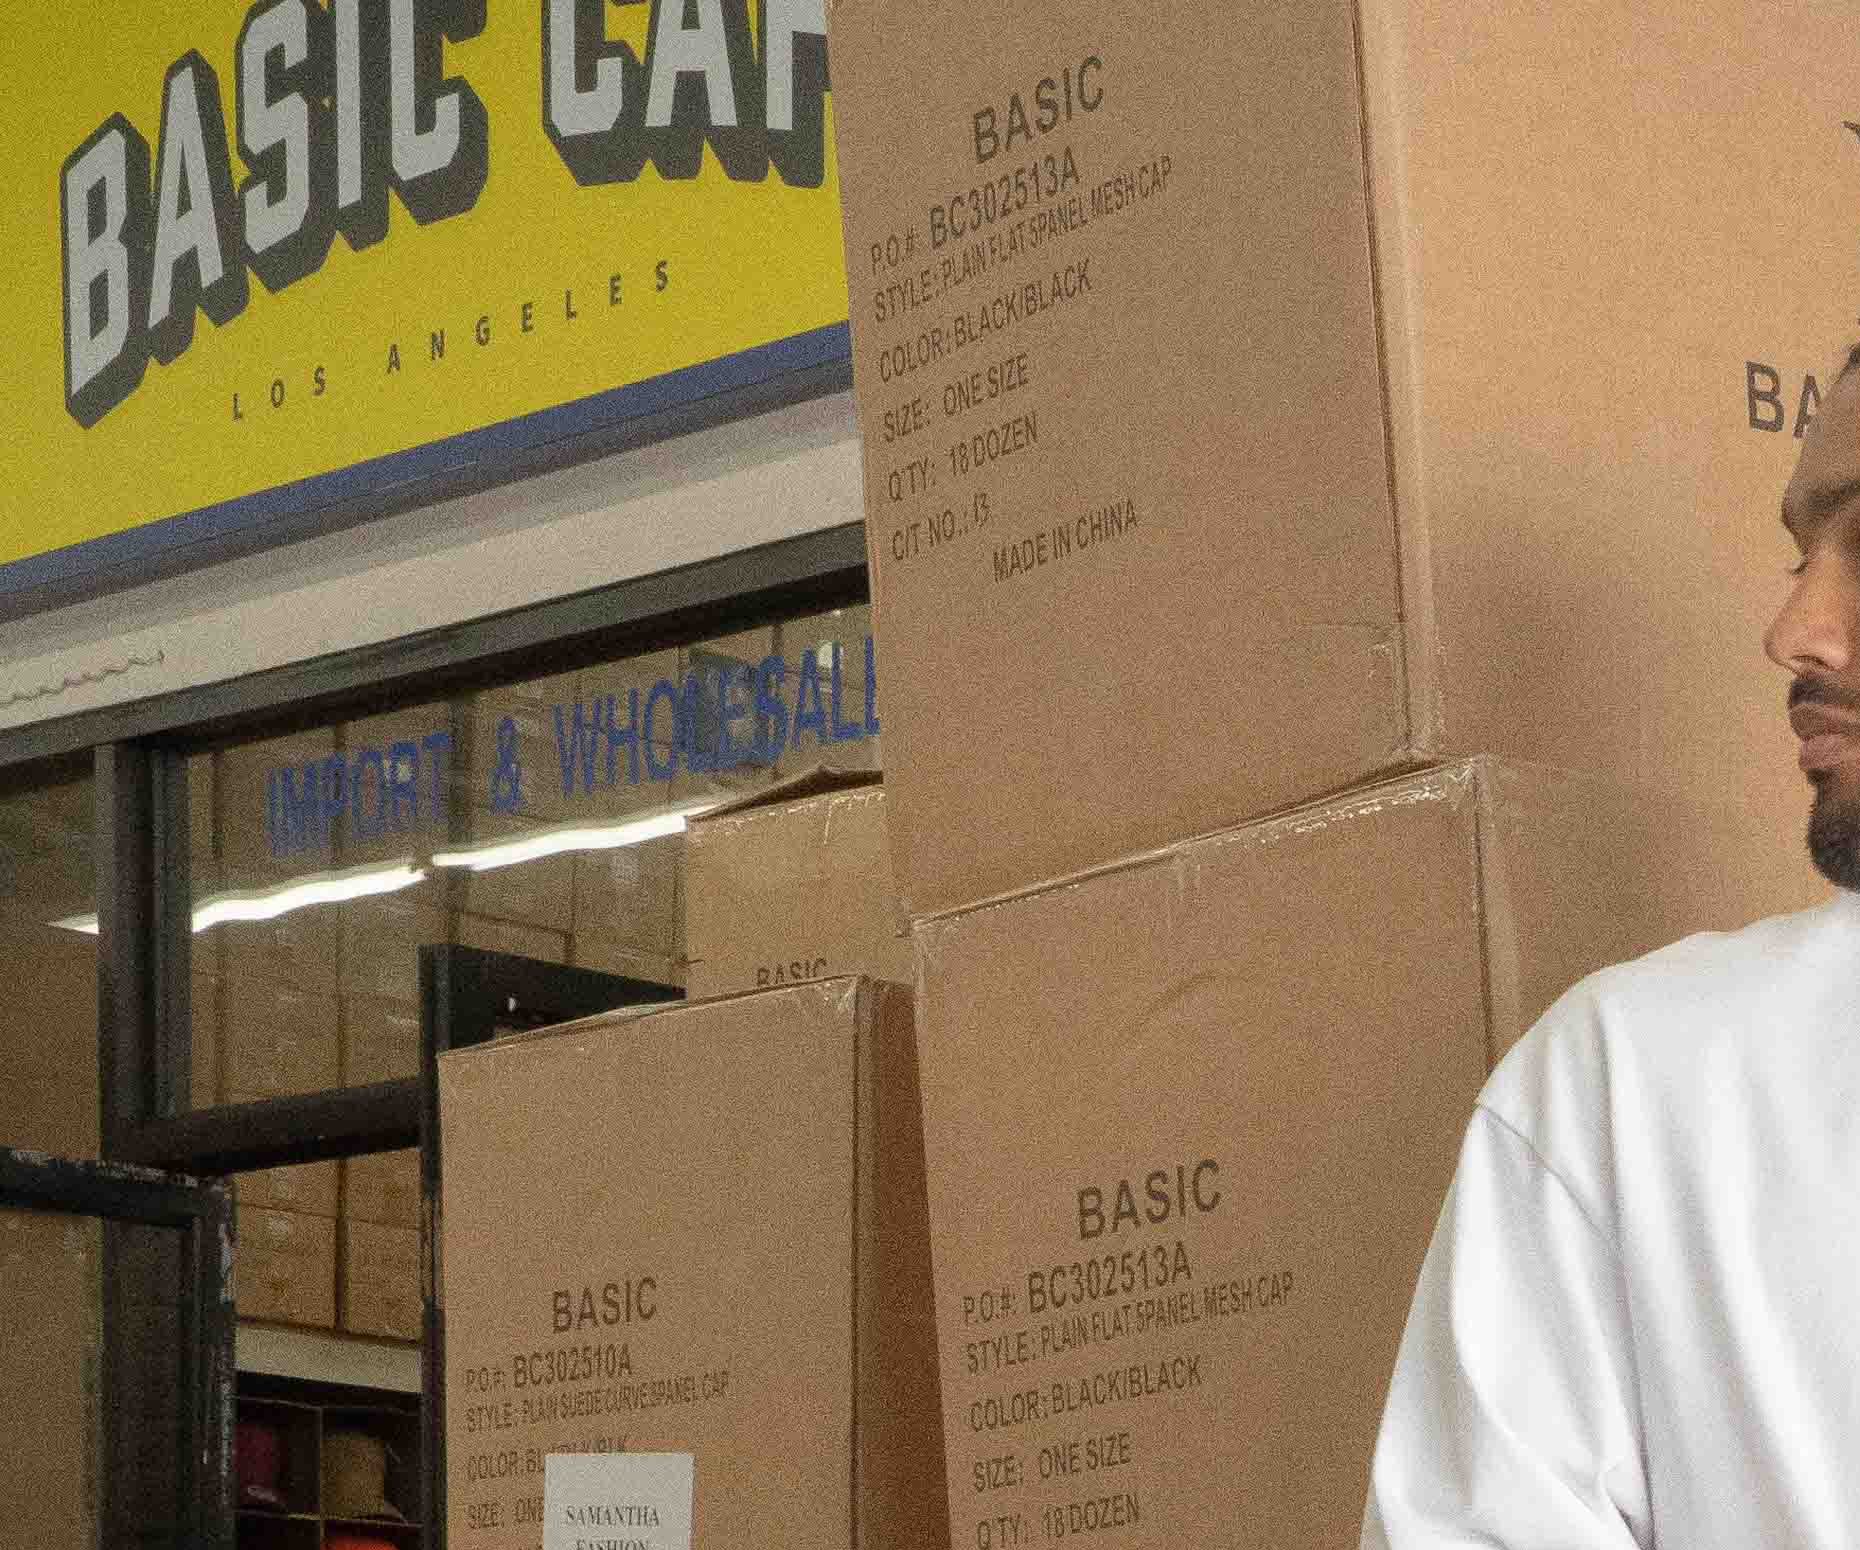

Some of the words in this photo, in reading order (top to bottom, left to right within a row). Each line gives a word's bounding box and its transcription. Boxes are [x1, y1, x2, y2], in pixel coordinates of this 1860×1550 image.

[971, 55, 1104, 165] BASIC
[61, 0, 488, 428] BASIC
[873, 267, 939, 323] STYLE:
[942, 244, 988, 287] PLAIN
[989, 221, 1026, 261] FLAT
[1090, 173, 1137, 215] MESH
[1138, 155, 1173, 198] CAP
[928, 146, 1081, 250] BC302513A
[232, 366, 327, 420] LOS
[387, 260, 669, 374] ANGELES
[879, 328, 950, 383] COLOR:
[953, 257, 1092, 349] BLACK/BLACK
[883, 398, 932, 443] SIZE:
[943, 372, 983, 416] ONE
[987, 353, 1030, 398] SIZE
[950, 441, 970, 475] 18
[972, 410, 1039, 467] DOZEN
[992, 533, 1049, 583] MADE
[1052, 527, 1072, 560] IN
[1074, 497, 1139, 549] CHINA
[265, 731, 453, 858] IMPORT
[490, 716, 525, 814] &
[1076, 1157, 1223, 1241] BASIC
[551, 1276, 659, 1334] BASIC
[1027, 1240, 1192, 1315] BC302513A
[966, 1331, 1037, 1374] STYLE:
[1041, 1316, 1088, 1352] PLAIN
[1090, 1303, 1131, 1341] FLAT
[1202, 1280, 1252, 1318] MESH
[1256, 1270, 1295, 1308] CAP
[513, 1343, 634, 1389] BC302510A
[970, 1389, 1048, 1433] COLOR:
[1051, 1355, 1202, 1416] BLACK/BLACK
[972, 1455, 1024, 1493] SIZE:
[1038, 1442, 1082, 1480] ONE
[1085, 1432, 1132, 1471] SIZE
[564, 1505, 661, 1527] SAMANTHA
[1043, 1507, 1066, 1539] 18
[1068, 1492, 1141, 1534] DOZEN
